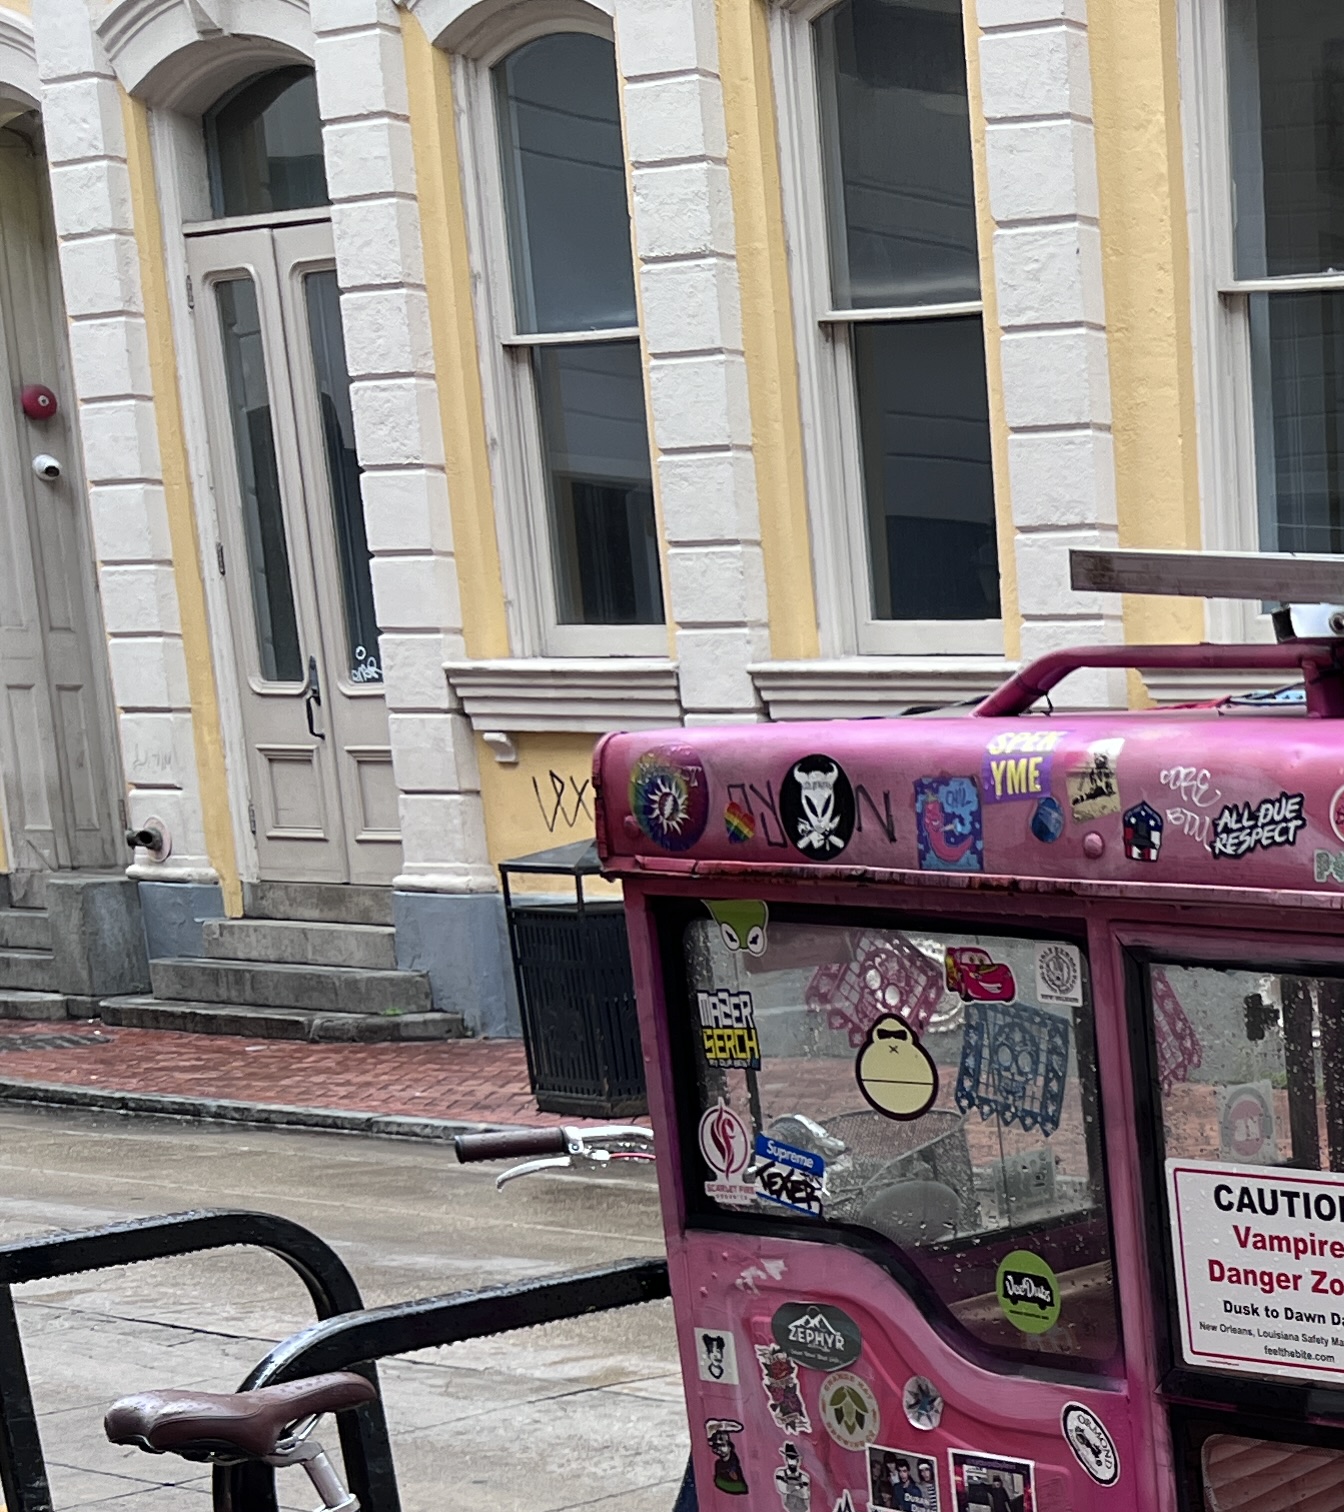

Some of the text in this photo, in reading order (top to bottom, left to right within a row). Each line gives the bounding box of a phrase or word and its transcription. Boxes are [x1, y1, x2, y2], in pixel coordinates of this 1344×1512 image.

[1216, 795, 1301, 833] ALL DUE
[1213, 820, 1303, 854] RESPECT
[766, 1140, 815, 1169] Supreme
[1207, 1259, 1303, 1294] Danger
[1223, 1300, 1260, 1317] Dusk
[1264, 1305, 1280, 1319] to
[1283, 1306, 1326, 1325] Dawn
[788, 1327, 846, 1351] ZEPHYR
[1199, 1321, 1218, 1333] New
[1219, 1323, 1256, 1338] Orleans,
[1256, 1327, 1300, 1343] Louisiana
[1301, 1333, 1330, 1348] Safety
[1264, 1345, 1335, 1363] feelthebite.com
